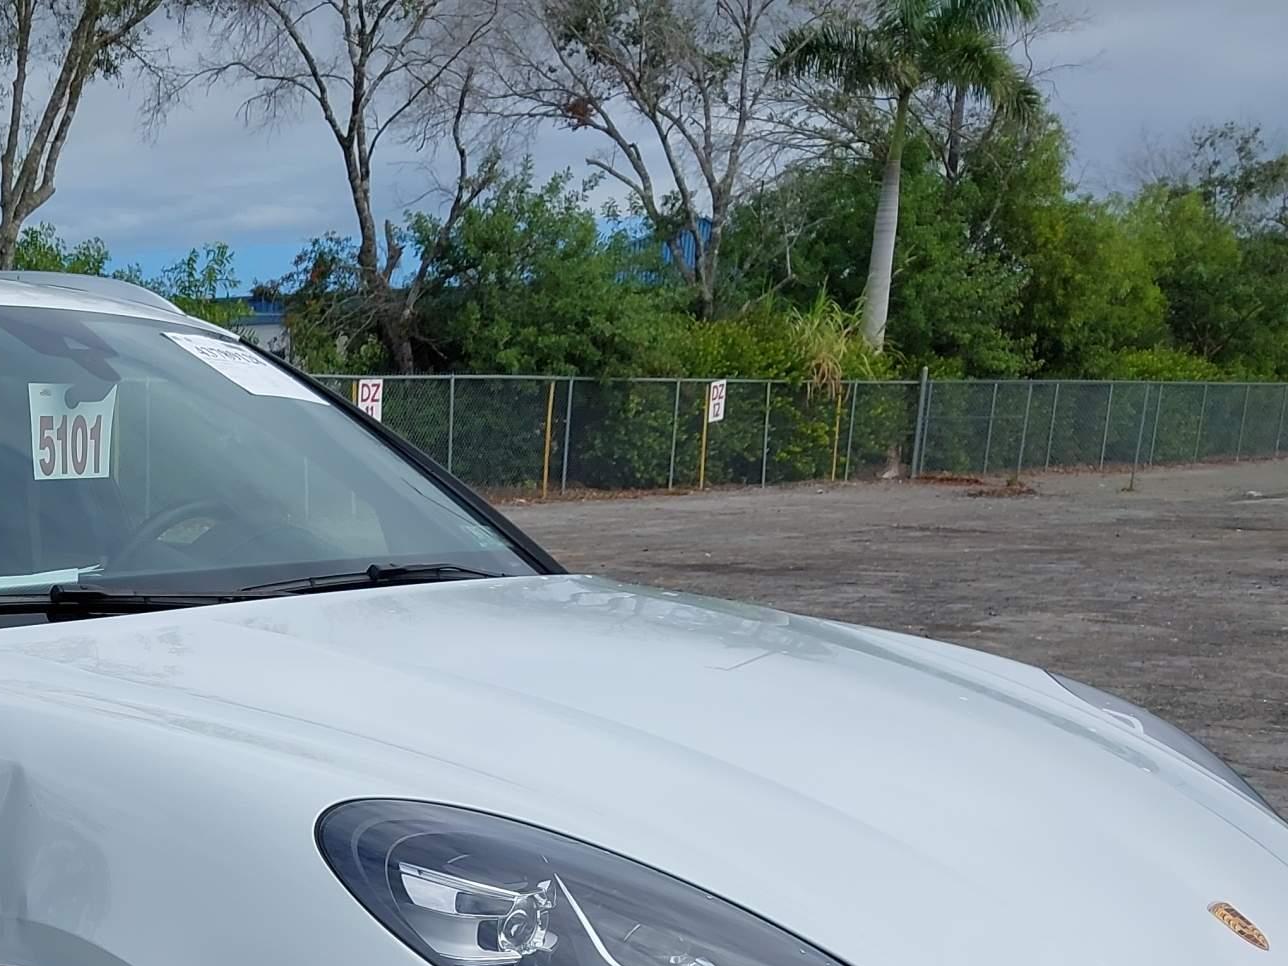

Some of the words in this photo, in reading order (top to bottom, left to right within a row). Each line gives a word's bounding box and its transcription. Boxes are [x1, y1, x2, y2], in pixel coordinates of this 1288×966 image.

[361, 383, 381, 402] DZ
[712, 384, 724, 400] DZ
[39, 414, 103, 476] 5101
